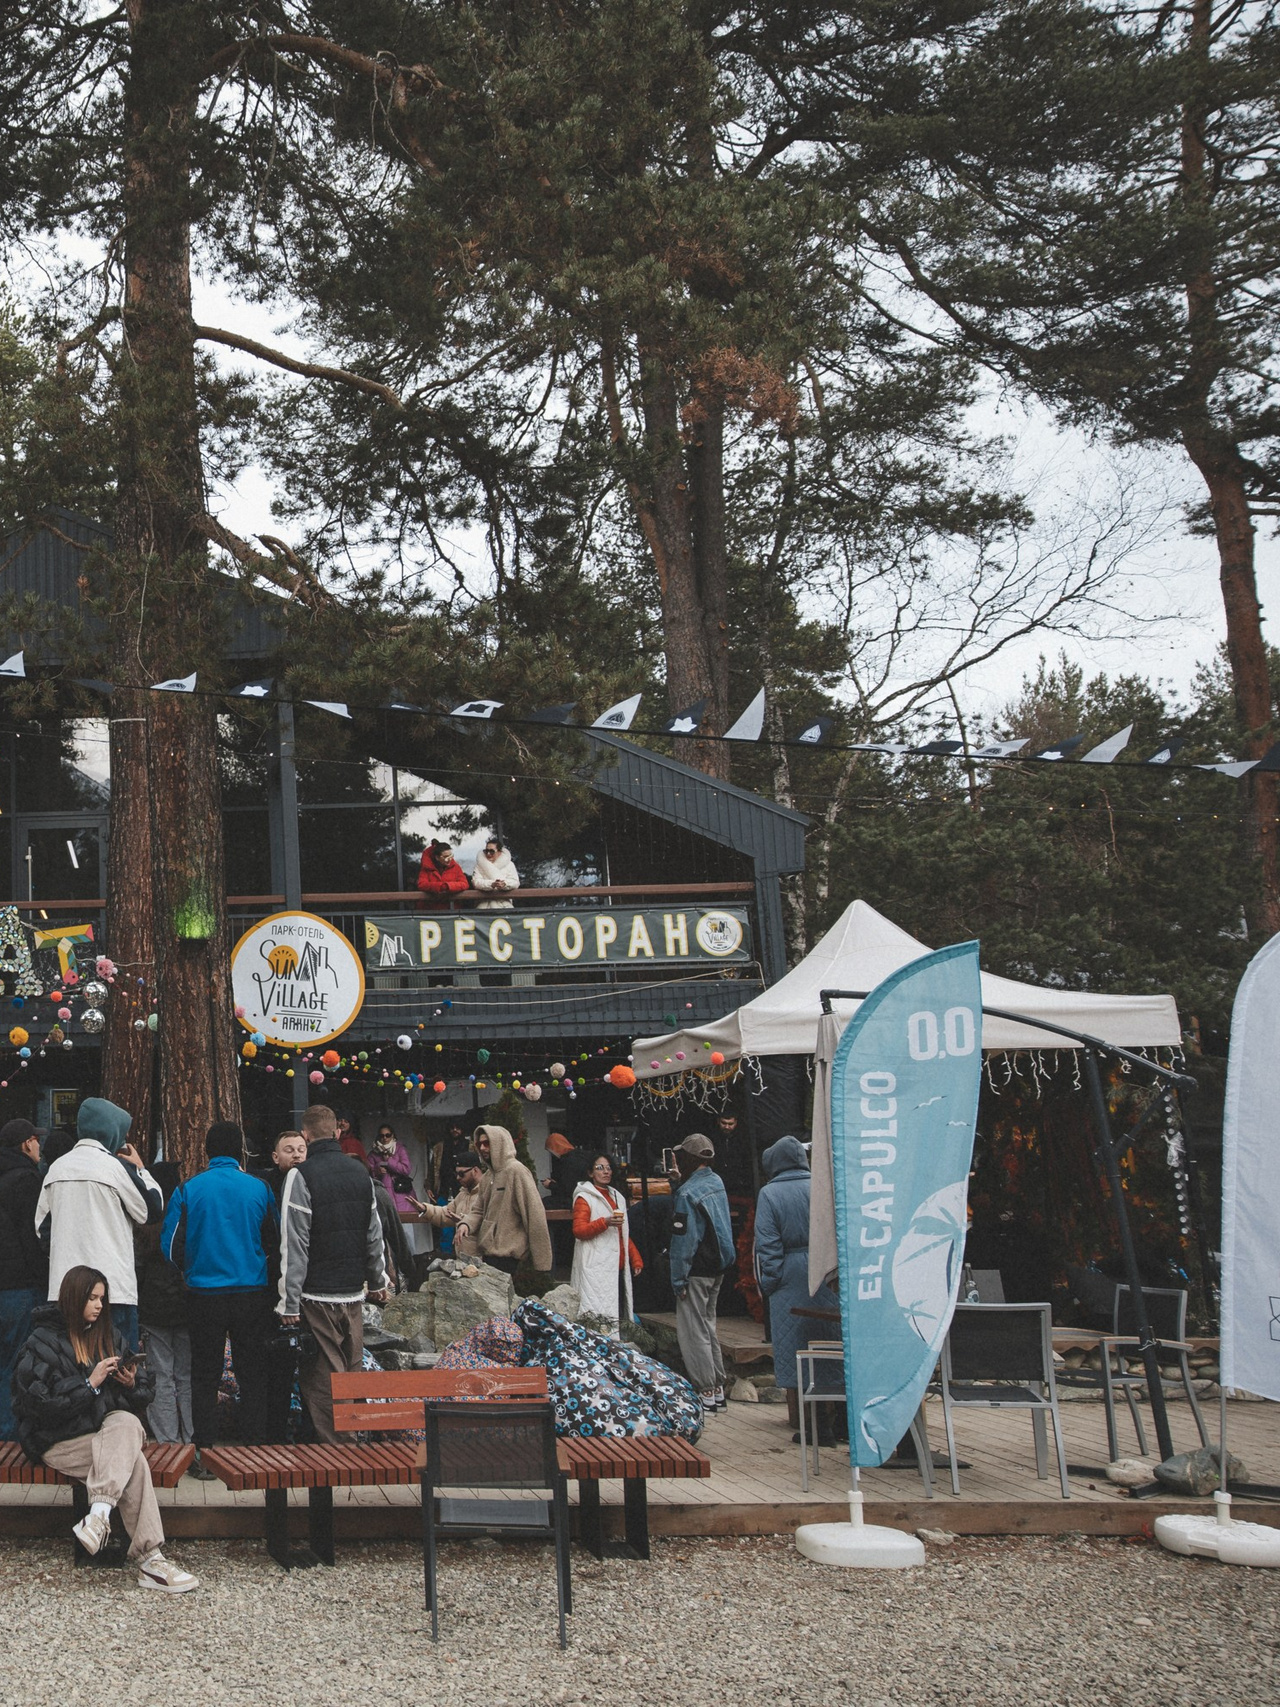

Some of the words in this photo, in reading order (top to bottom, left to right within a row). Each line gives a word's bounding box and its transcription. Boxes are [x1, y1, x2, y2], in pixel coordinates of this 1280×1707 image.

[271, 924, 325, 940] ПАРК-ОТЕЛЬ
[419, 913, 689, 964] РЕСТОРАН
[859, 1070, 898, 1249] CAPULCO
